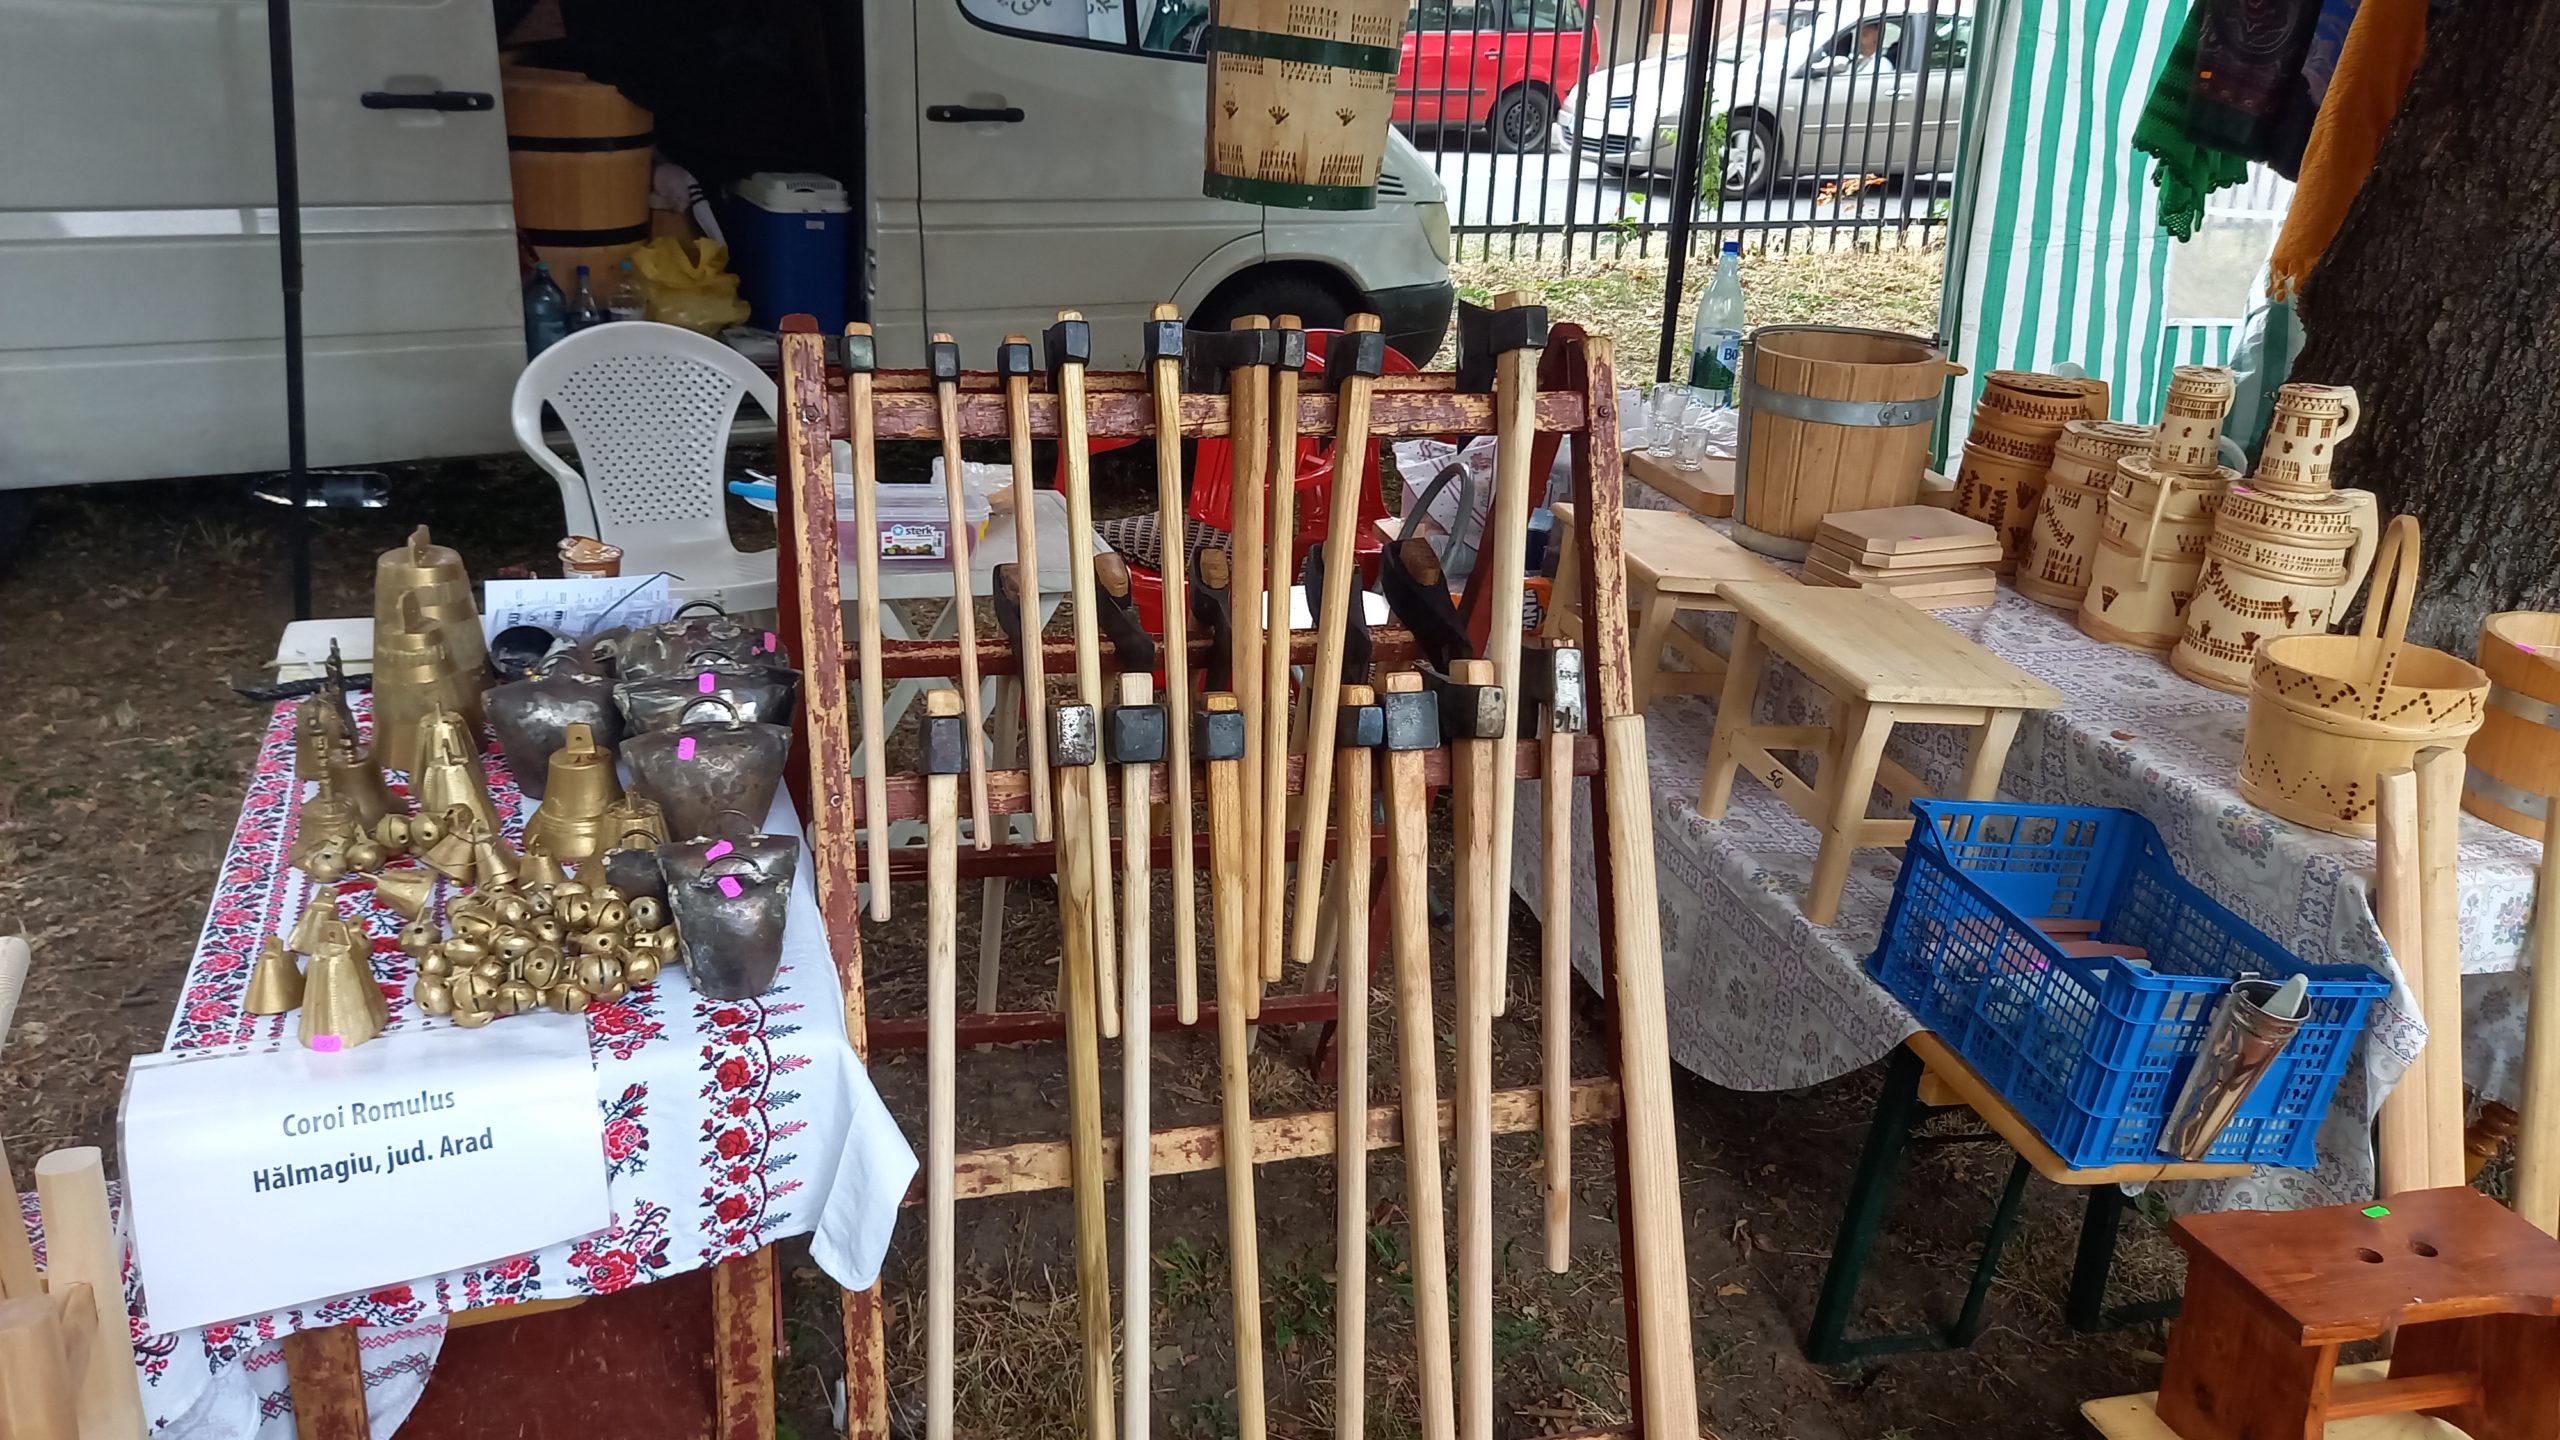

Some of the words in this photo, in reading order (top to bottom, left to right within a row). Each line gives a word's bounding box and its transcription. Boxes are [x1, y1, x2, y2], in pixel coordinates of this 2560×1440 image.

[905, 527, 933, 535] sterk
[1522, 588, 1538, 632] FANTA
[1766, 769, 1784, 789] 50
[282, 1104, 345, 1137] Coroi
[351, 1090, 456, 1126] Romulus
[252, 1149, 383, 1194] Hălmagiu,
[386, 1139, 435, 1175] jud.
[439, 1126, 495, 1159] Arad
